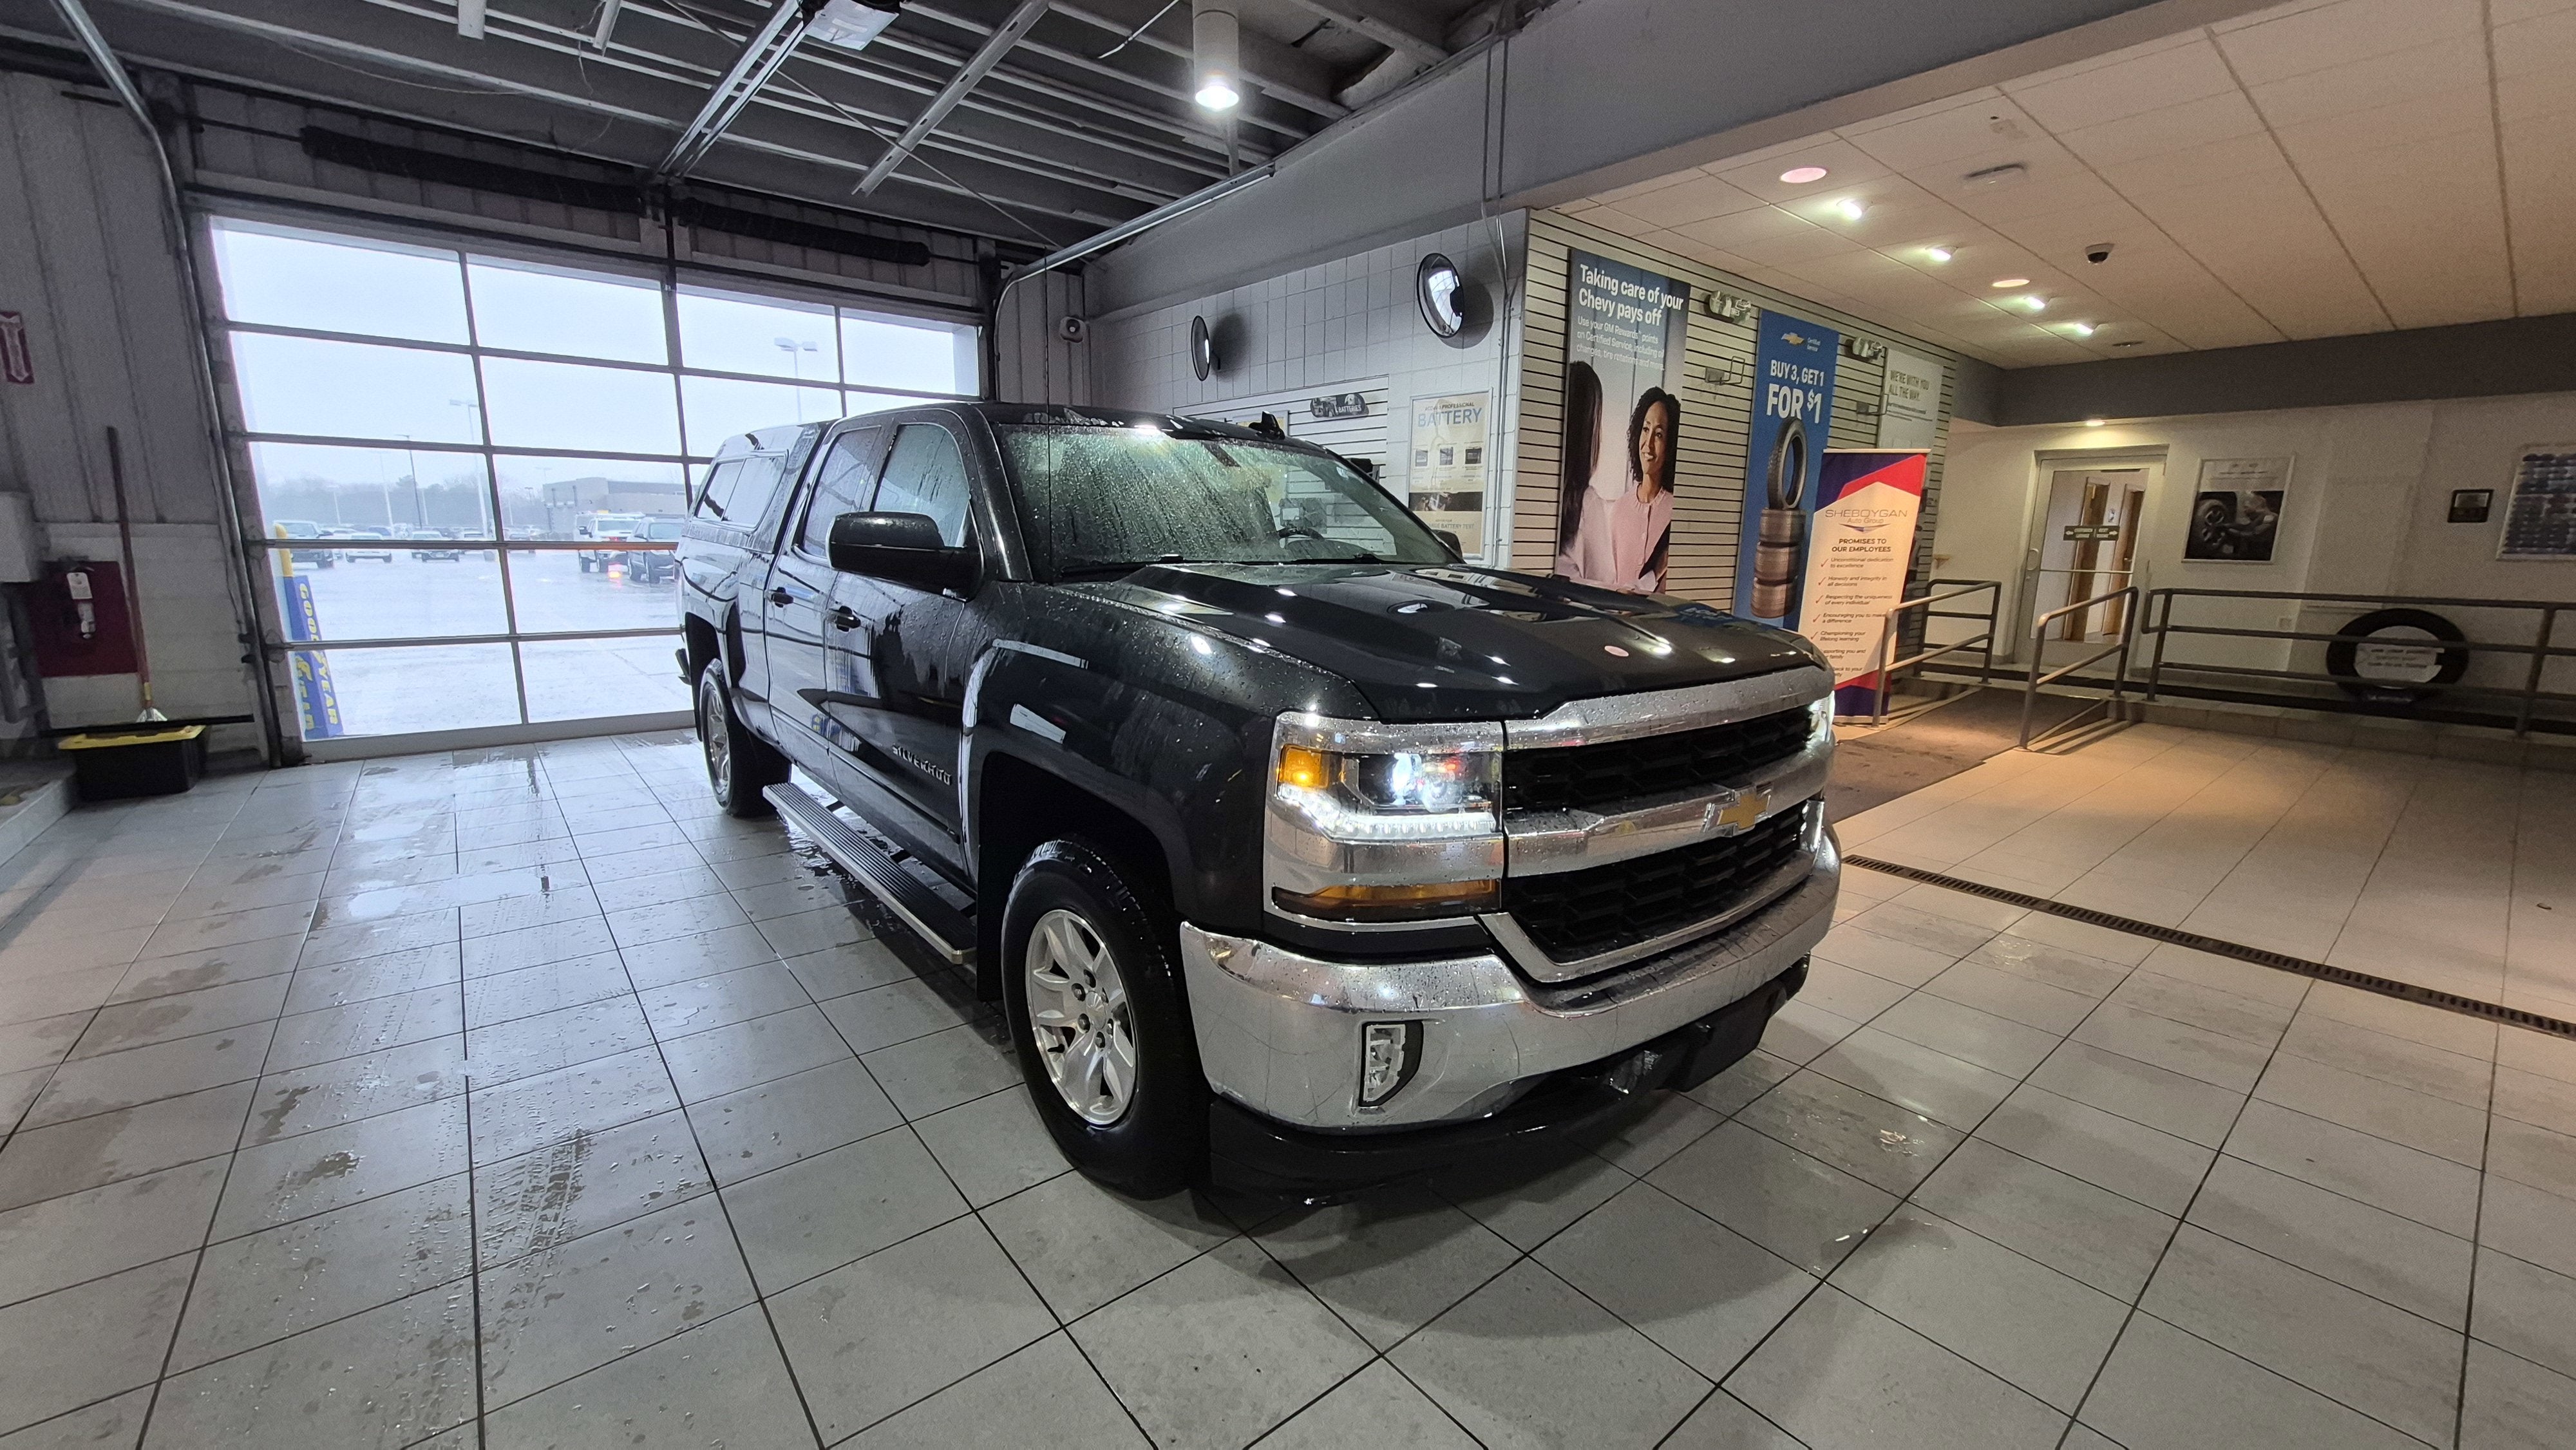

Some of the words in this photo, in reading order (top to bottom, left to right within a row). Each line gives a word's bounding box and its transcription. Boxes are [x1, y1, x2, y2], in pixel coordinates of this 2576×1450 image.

[1580, 263, 1619, 296] Taking
[1621, 281, 1645, 301] care
[1647, 287, 1660, 304] of
[1660, 292, 1684, 310] your
[1578, 288, 1616, 317] Chevy
[1617, 303, 1643, 323] pays
[1645, 308, 1662, 326] off
[1578, 315, 1589, 326] Use
[1590, 321, 1604, 330] your
[1604, 323, 1614, 333] GM
[1642, 334, 1659, 344] points
[1586, 331, 1611, 346] Certified
[1634, 343, 1658, 359] including
[1770, 359, 1790, 379] BUY
[1790, 364, 1800, 384] 3,
[1801, 367, 1821, 386] GET
[1820, 371, 1825, 387] 1
[1418, 408, 1482, 427] BATTERY
[1766, 383, 1804, 420] FOR
[1806, 388, 1823, 424] $1
[1825, 509, 1908, 518] SHEBOYGAN
